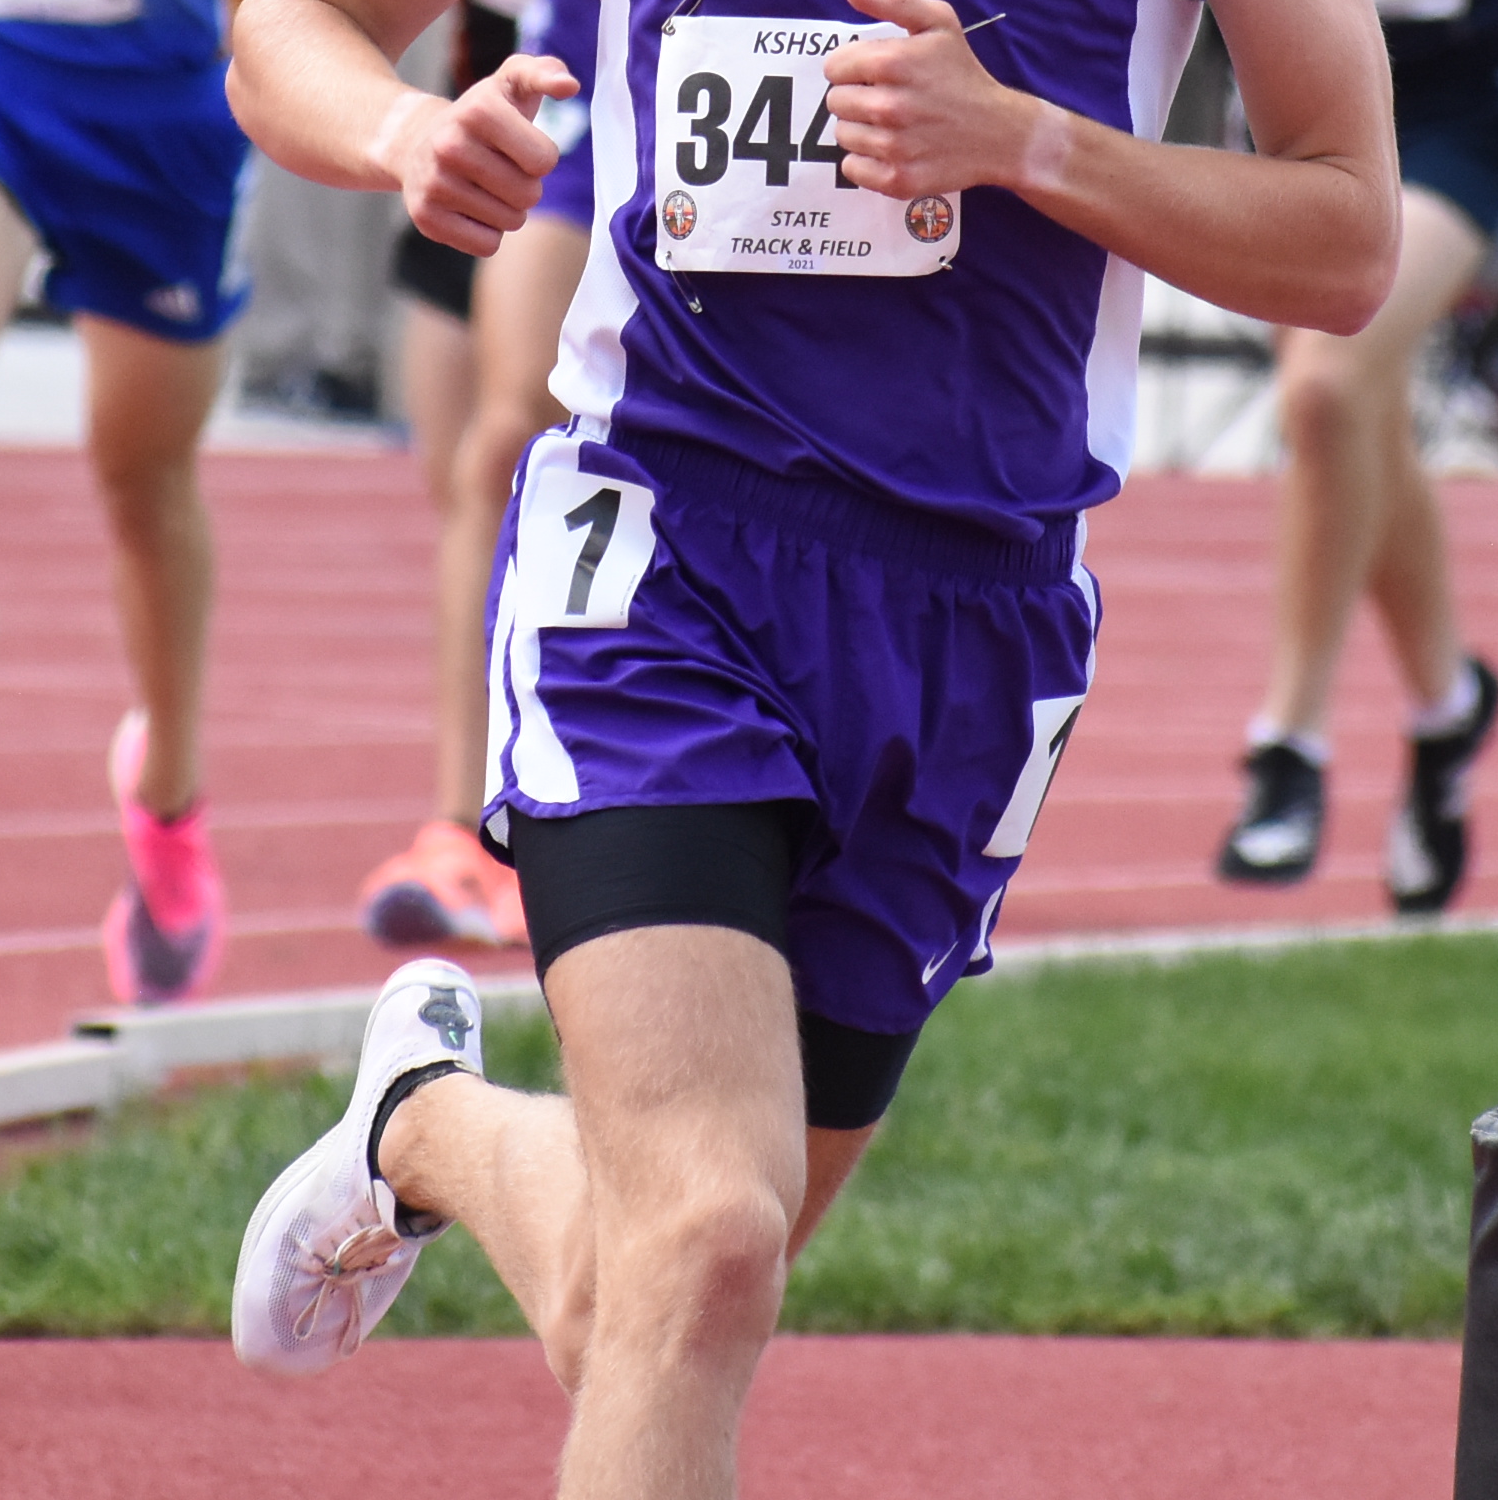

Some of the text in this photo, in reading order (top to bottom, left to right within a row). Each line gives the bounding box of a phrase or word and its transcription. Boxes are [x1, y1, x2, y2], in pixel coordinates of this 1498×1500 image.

[675, 71, 860, 190] 344
[770, 210, 831, 228] STATE
[731, 237, 872, 257] TRACK & FIELD
[787, 259, 814, 270] 2021
[563, 487, 622, 616] 1
